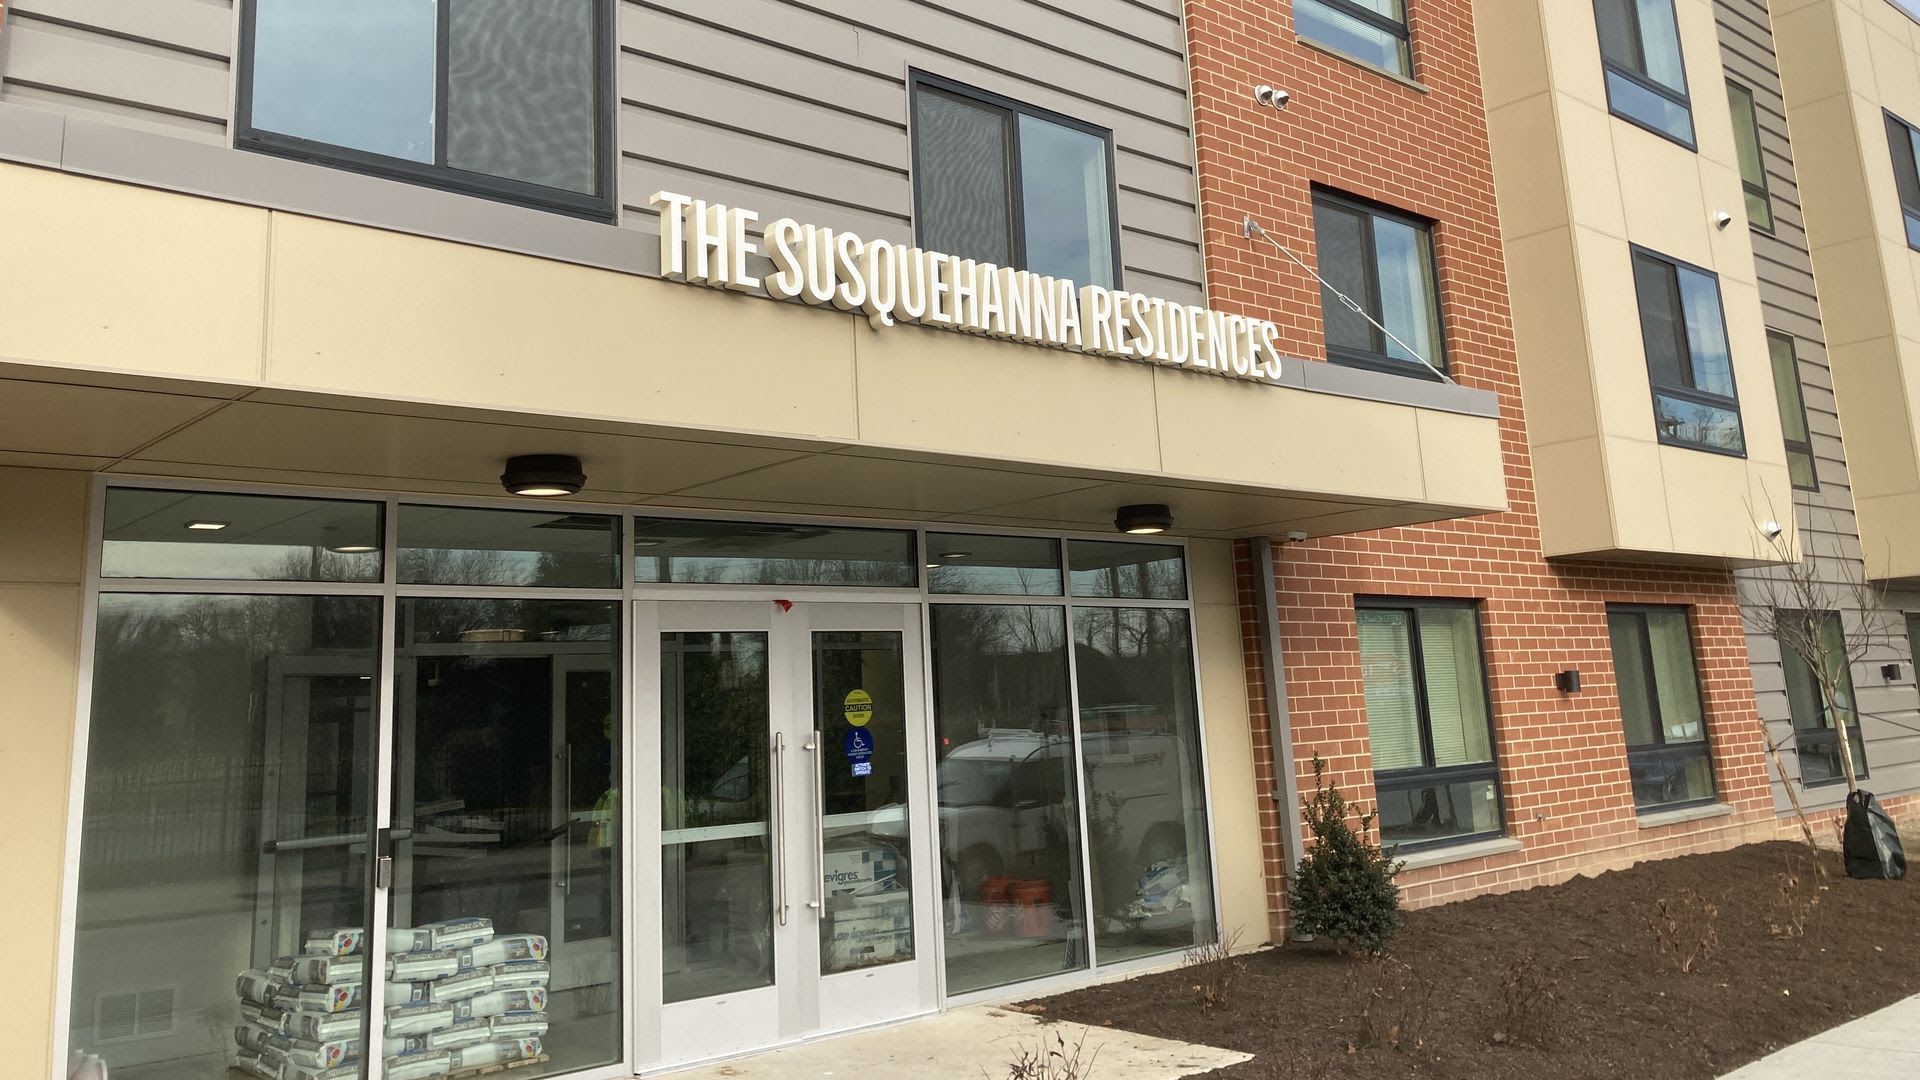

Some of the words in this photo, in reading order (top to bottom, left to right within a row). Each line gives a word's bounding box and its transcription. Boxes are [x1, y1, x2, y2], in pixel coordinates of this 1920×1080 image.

[650, 190, 763, 292] THE
[765, 216, 1083, 348] SUSQUEHANNA
[1081, 285, 1284, 382] RESIDENCES
[845, 704, 872, 712] CAUTION
[824, 870, 859, 885] evigres
